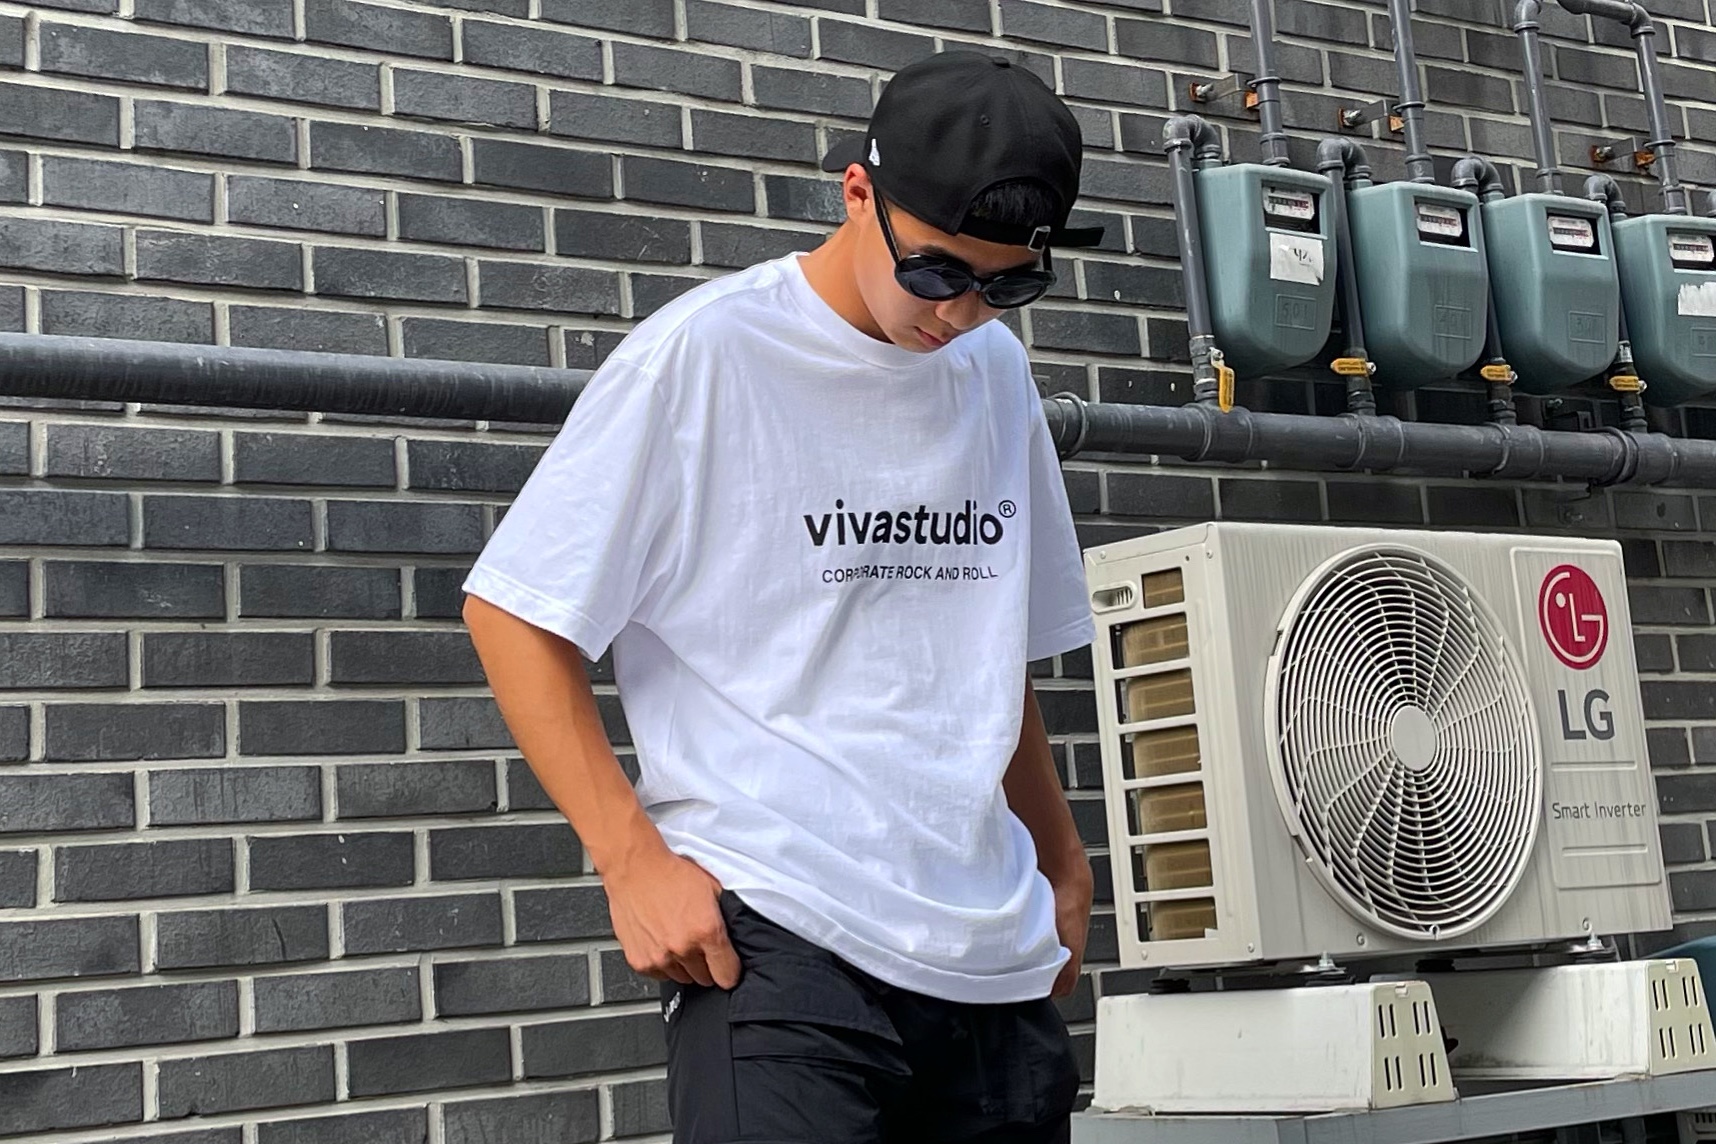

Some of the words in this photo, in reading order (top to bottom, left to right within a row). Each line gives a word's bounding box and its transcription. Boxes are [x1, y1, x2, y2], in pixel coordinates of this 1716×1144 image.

[896, 565, 933, 580] ROCK
[935, 566, 960, 581] AND
[963, 566, 999, 581] ROLL
[1557, 689, 1616, 741] LG
[1552, 802, 1591, 819] Smart
[1594, 801, 1646, 819] Inverter
